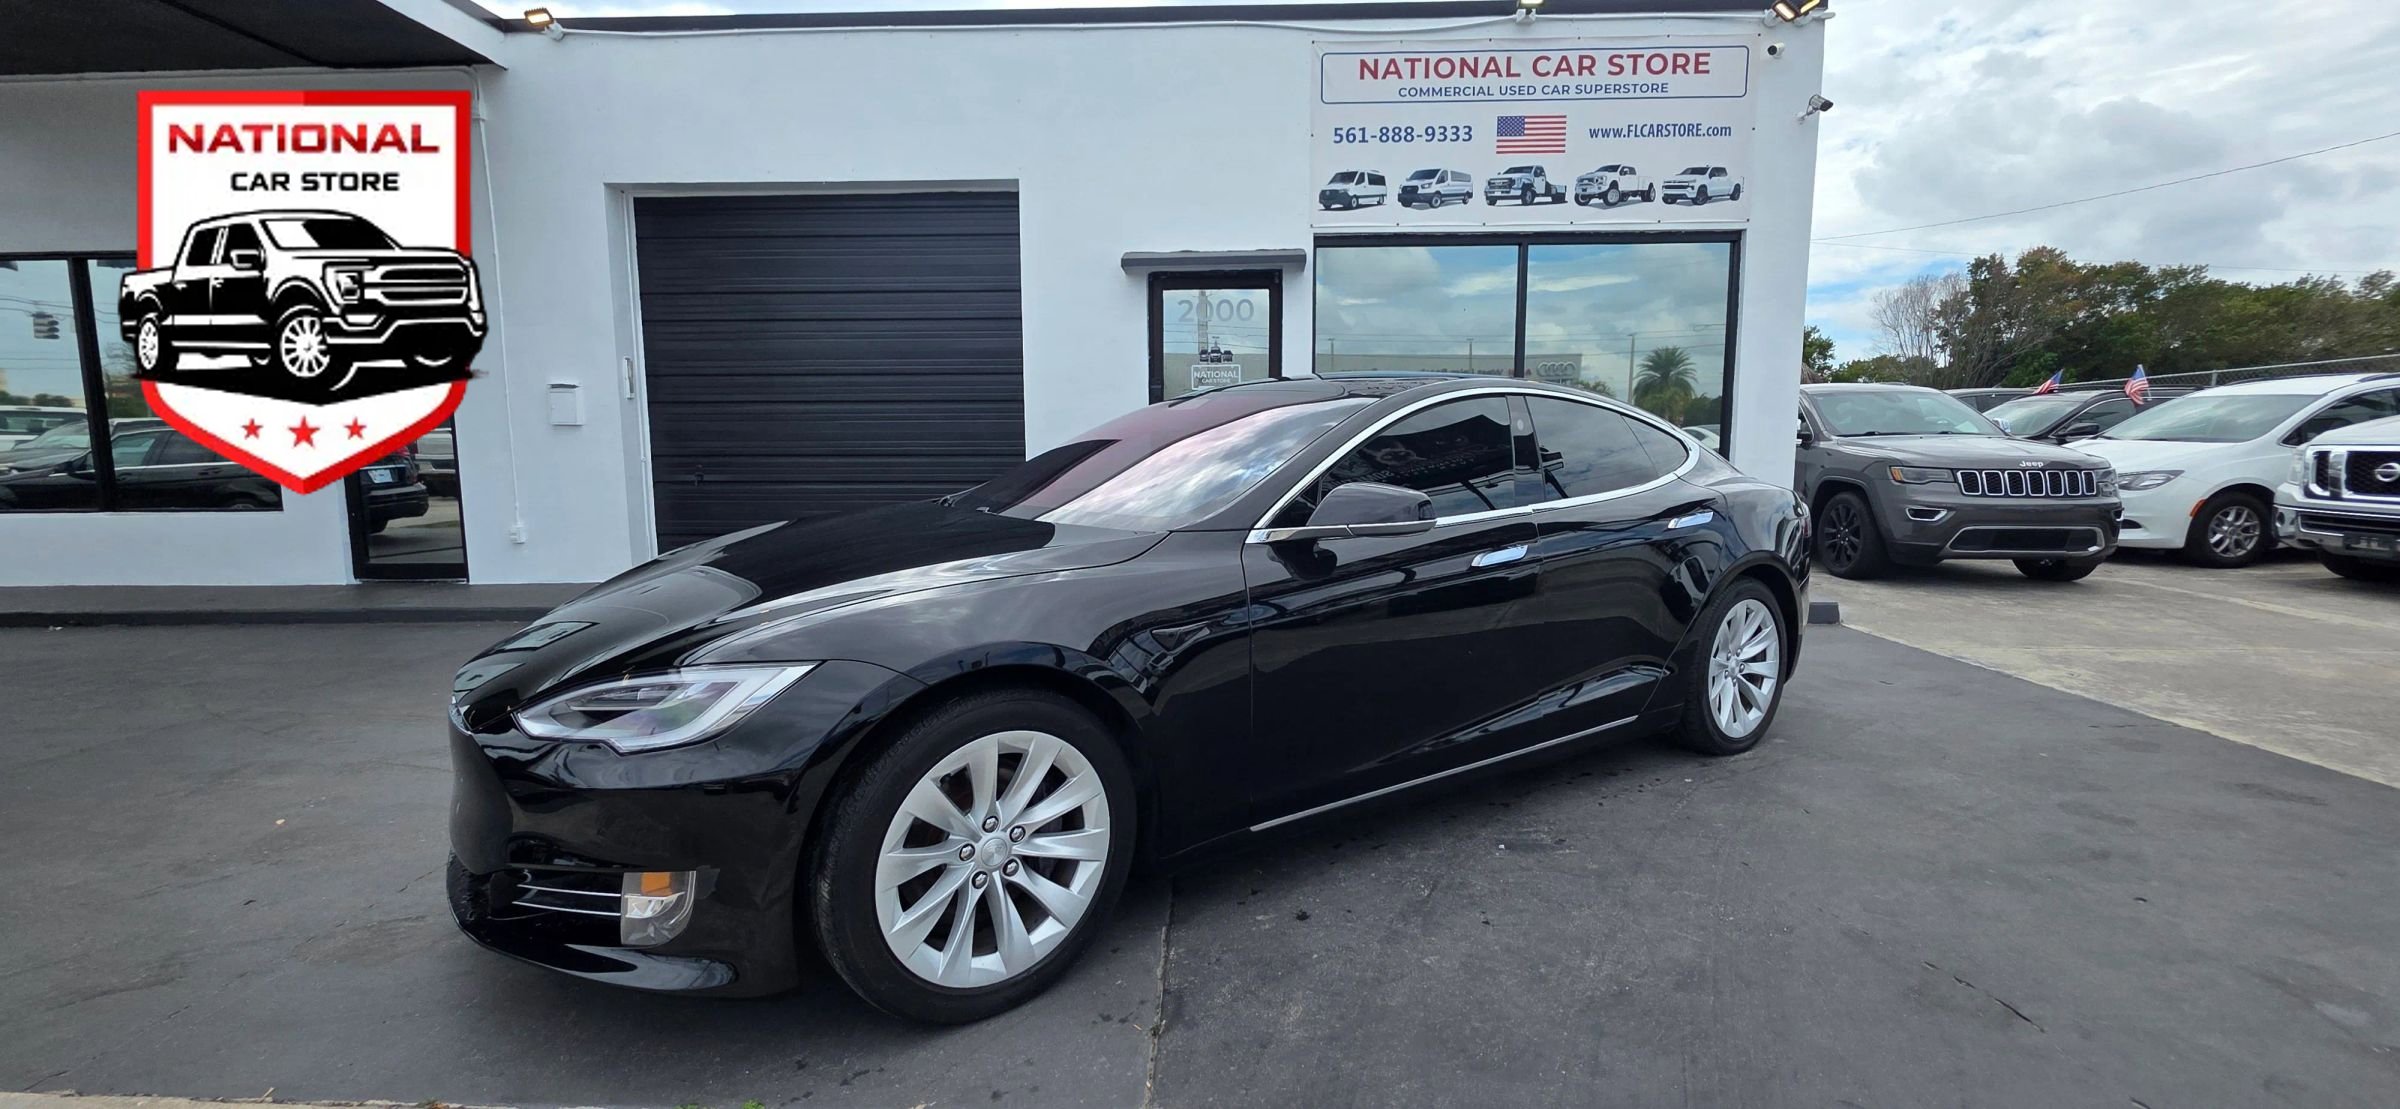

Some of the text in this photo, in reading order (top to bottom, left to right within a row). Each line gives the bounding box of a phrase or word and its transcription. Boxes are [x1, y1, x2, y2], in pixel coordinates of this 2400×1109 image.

[1359, 52, 1711, 80] NATIONAL CAR STORE
[1398, 83, 1669, 97] COMMERCIAL USED CAR SUPERSTORE
[1333, 126, 1473, 143] 561-888-9333
[1589, 123, 1732, 138] www.FLCARSTORE.com
[1177, 299, 1254, 322] 2000
[1193, 370, 1238, 378] NATIONAL
